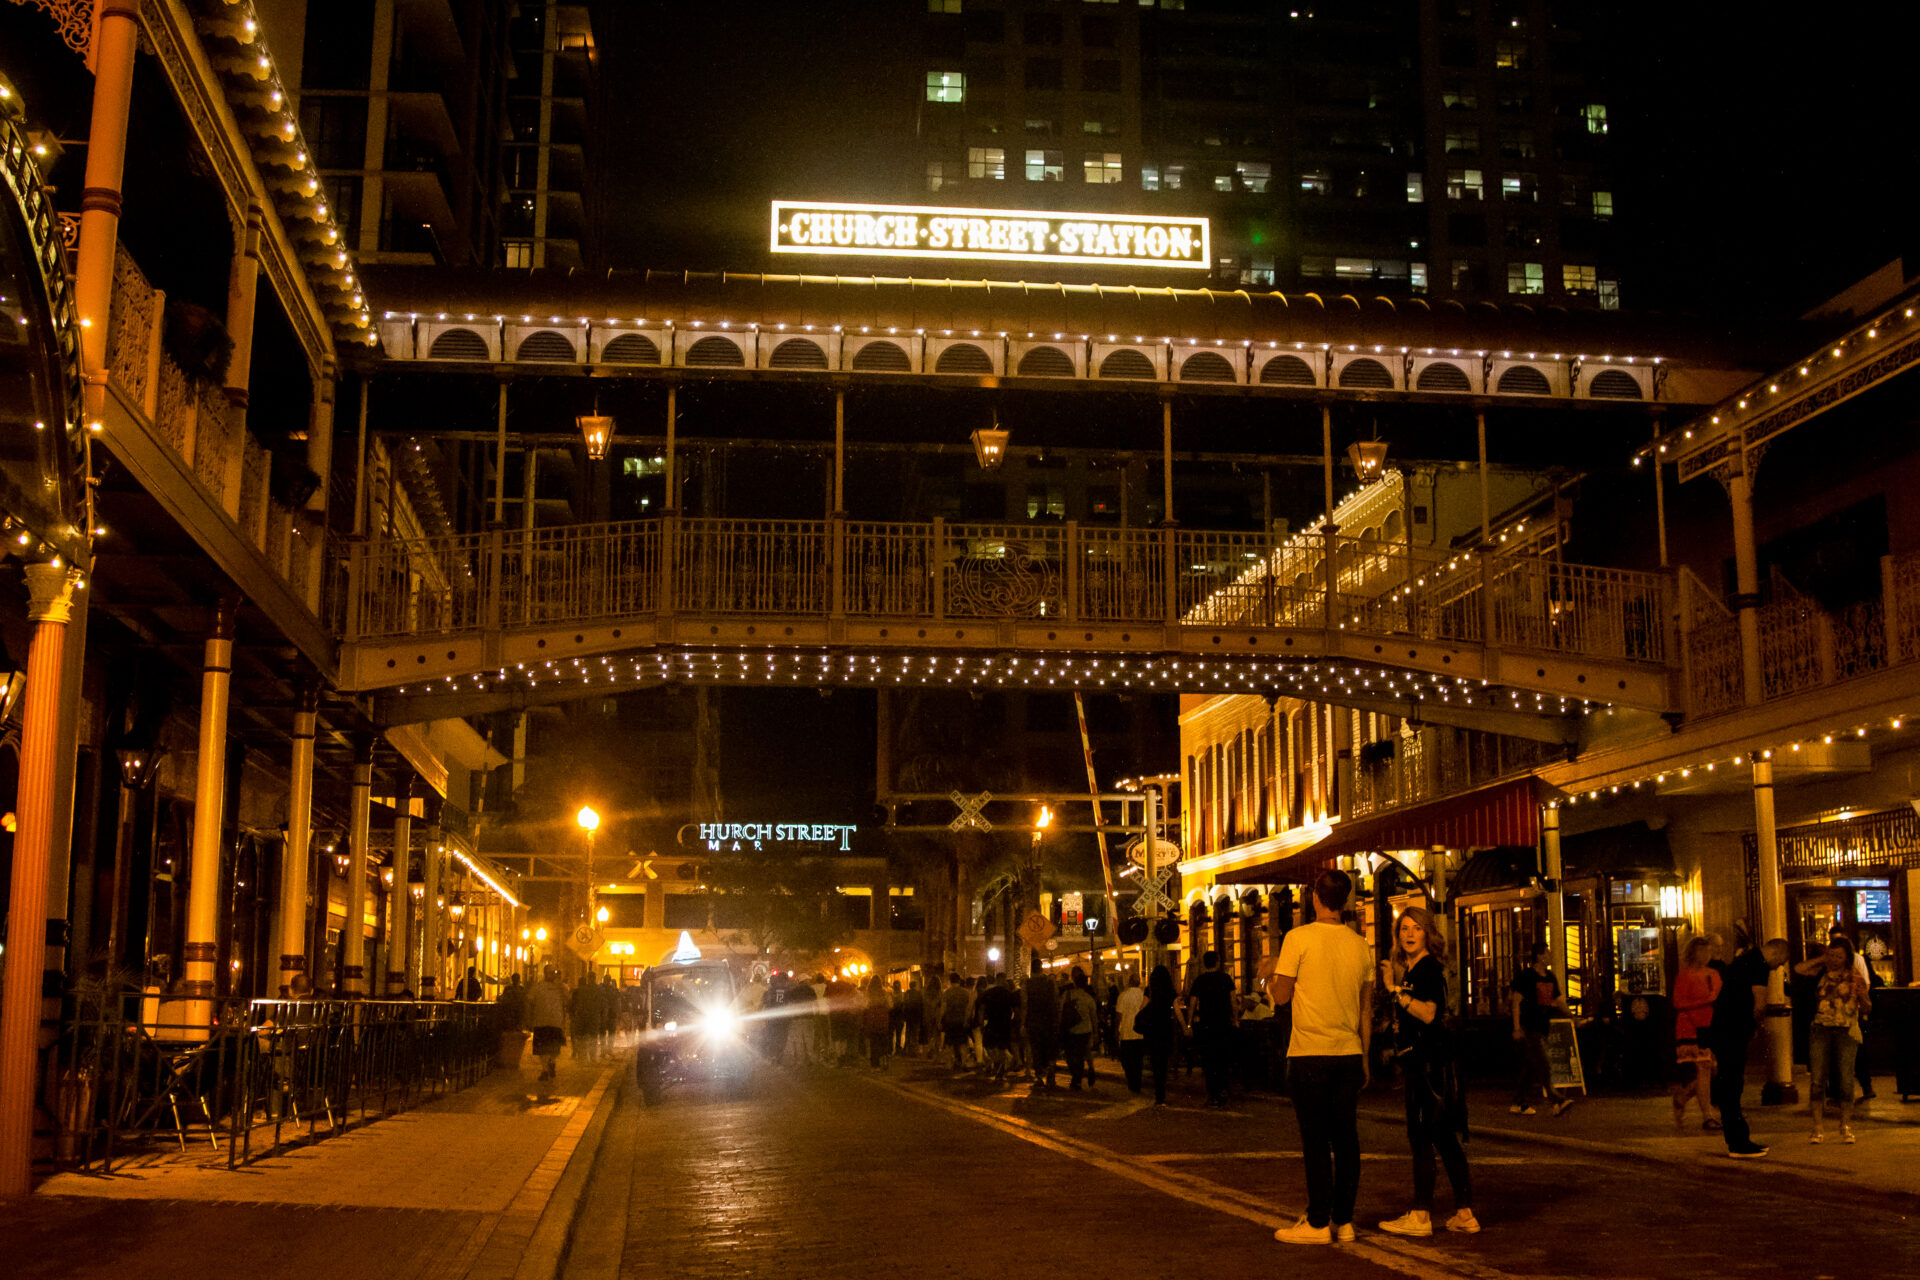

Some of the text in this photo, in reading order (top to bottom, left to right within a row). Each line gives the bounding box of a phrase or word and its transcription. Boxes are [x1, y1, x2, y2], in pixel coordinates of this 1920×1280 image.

[789, 211, 1193, 260] CHURCH STREET STATION
[776, 824, 858, 852] STREET
[1135, 848, 1177, 858] MRY'S
